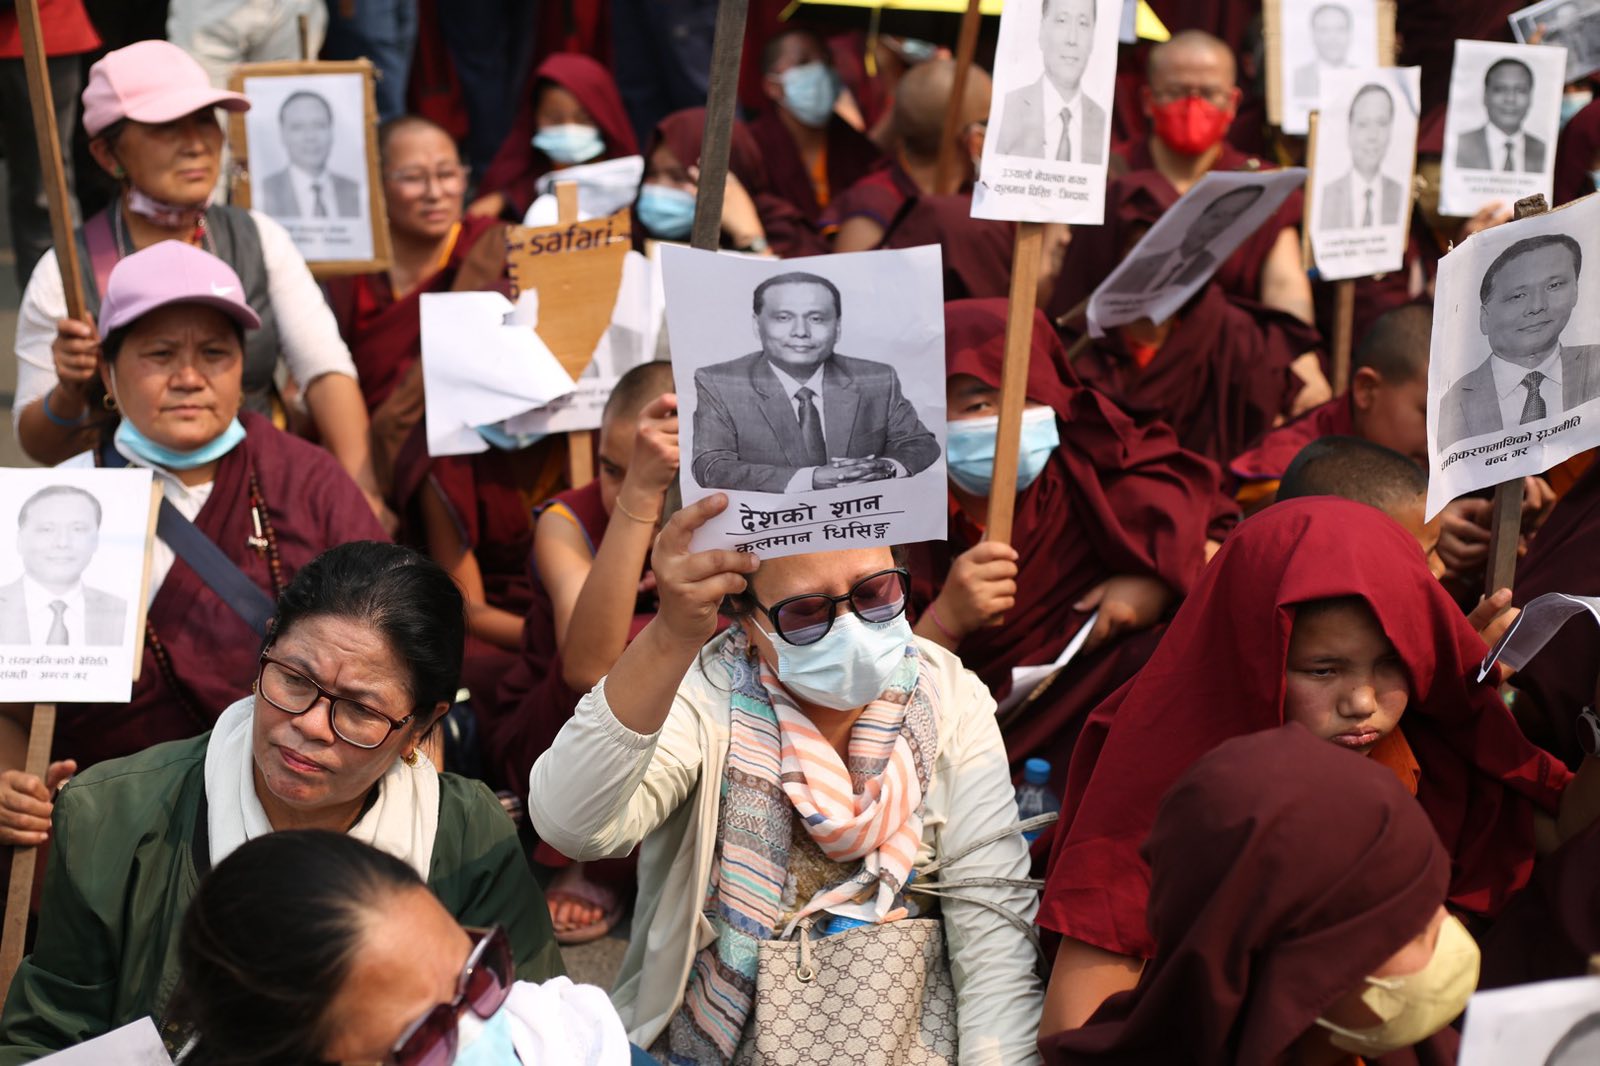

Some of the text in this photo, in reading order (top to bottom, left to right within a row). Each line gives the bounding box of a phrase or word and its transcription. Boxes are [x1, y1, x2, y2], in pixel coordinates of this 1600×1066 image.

[530, 221, 613, 256] safari
[1511, 446, 1530, 458] गर
[739, 494, 883, 533] देशको शान
